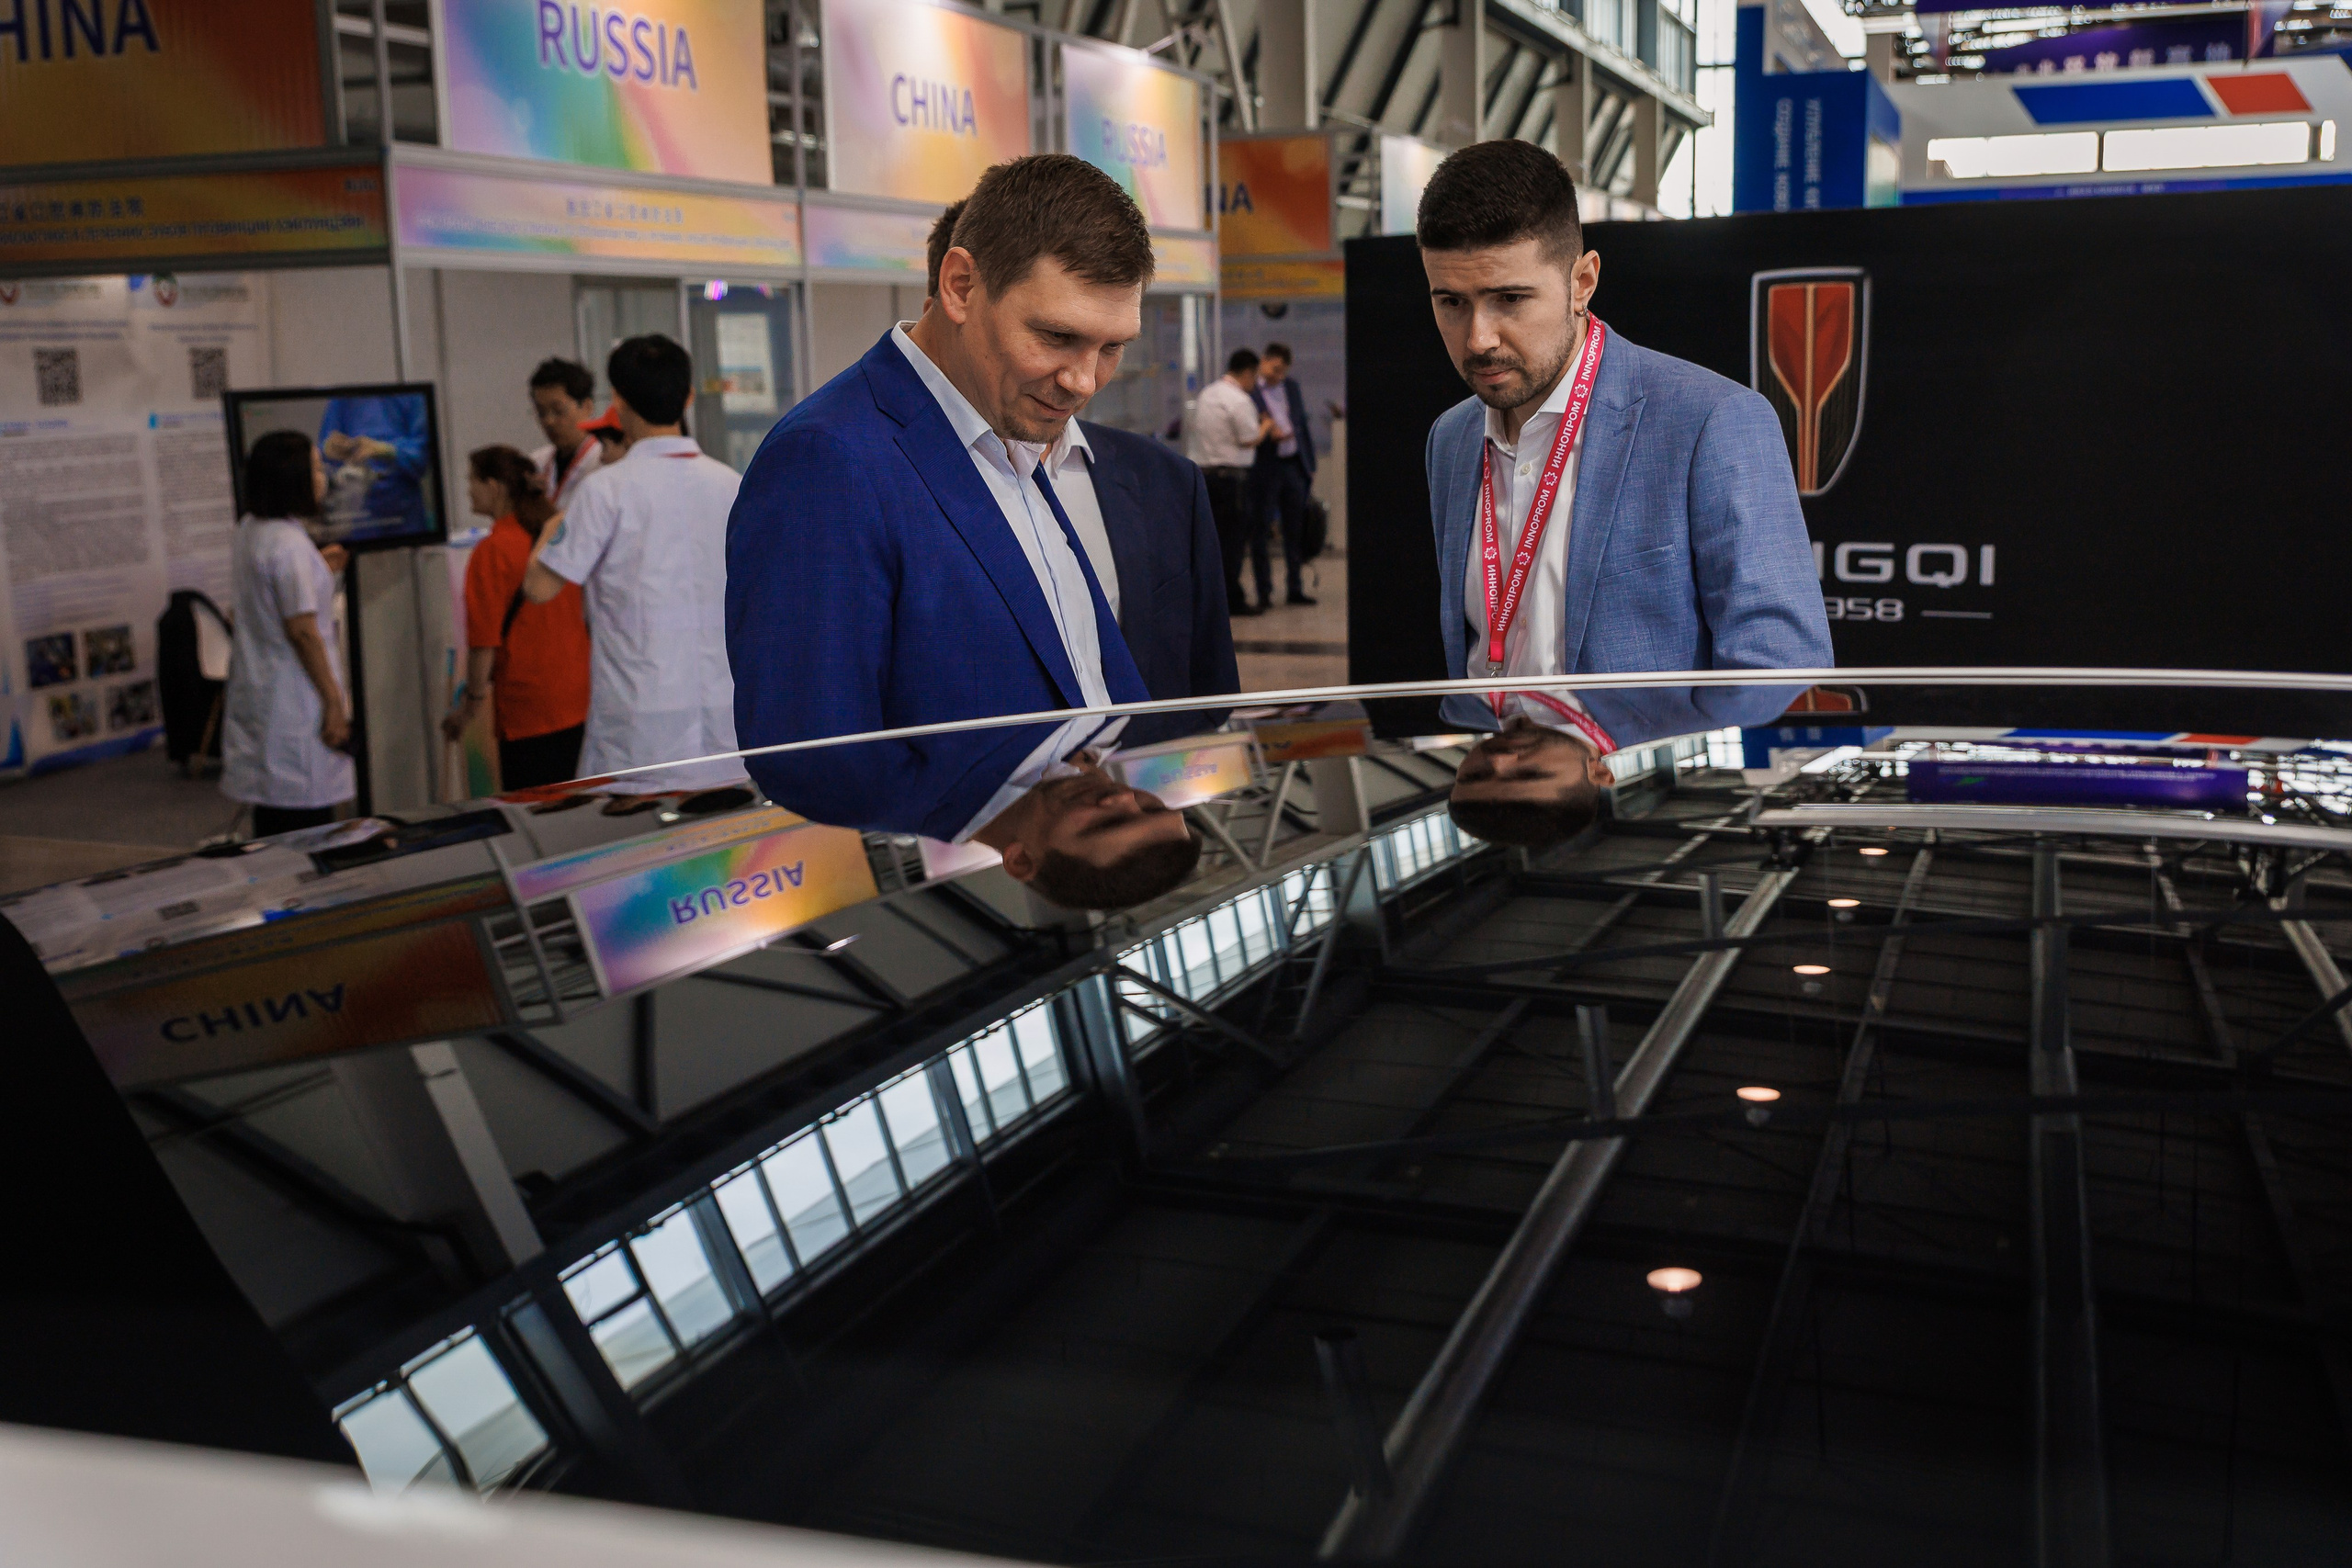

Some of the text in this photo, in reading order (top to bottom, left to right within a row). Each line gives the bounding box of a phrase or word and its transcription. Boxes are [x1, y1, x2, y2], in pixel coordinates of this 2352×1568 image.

[539, 0, 697, 91] RUSSIA
[891, 74, 978, 138] CHINA
[1102, 117, 1169, 170] RUSSIA
[1497, 324, 1601, 632] ИННОПРОМ INNOPROM ИННОПРОМ INNOPROM
[1485, 483, 1499, 626] INNOPROM ИННОПРО
